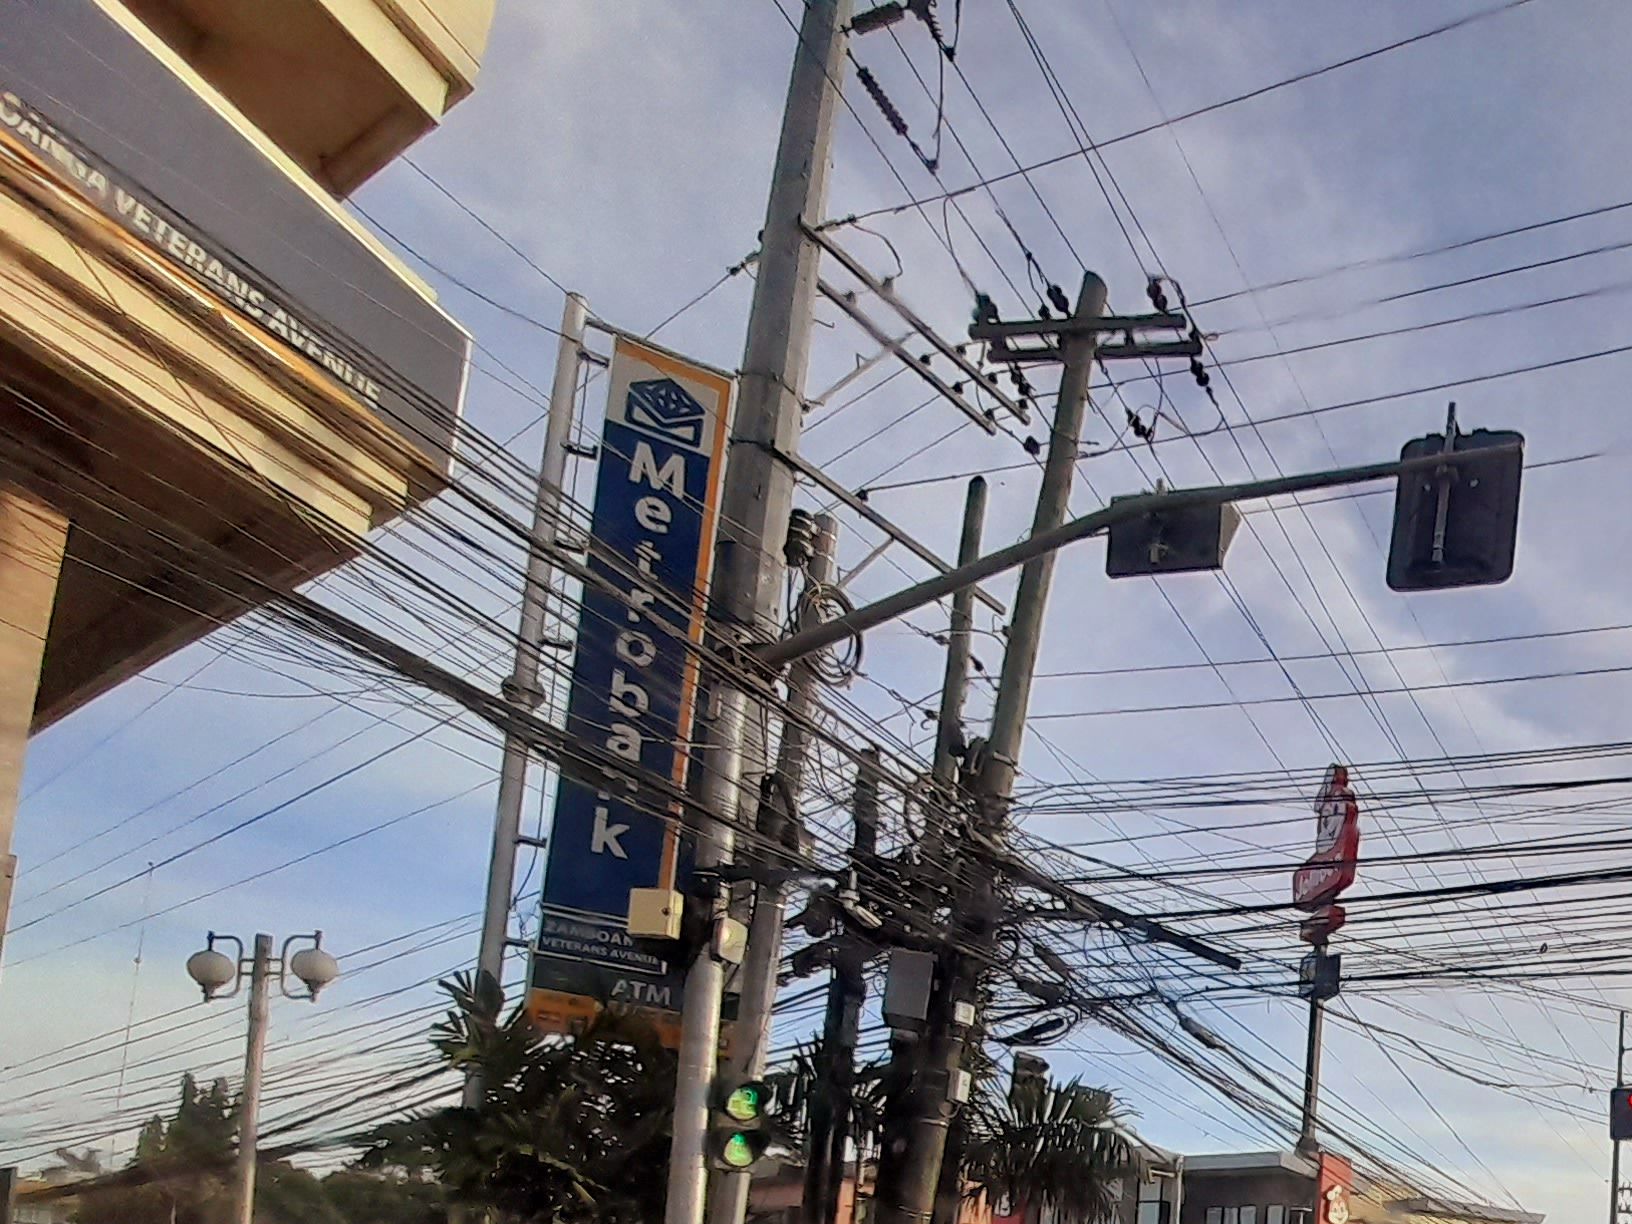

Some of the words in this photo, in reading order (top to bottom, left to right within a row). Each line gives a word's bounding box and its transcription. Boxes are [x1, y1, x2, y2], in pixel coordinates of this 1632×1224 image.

[115, 187, 265, 320] VETERANS
[542, 936, 607, 956] VETERANS
[611, 978, 671, 1006] ATM
